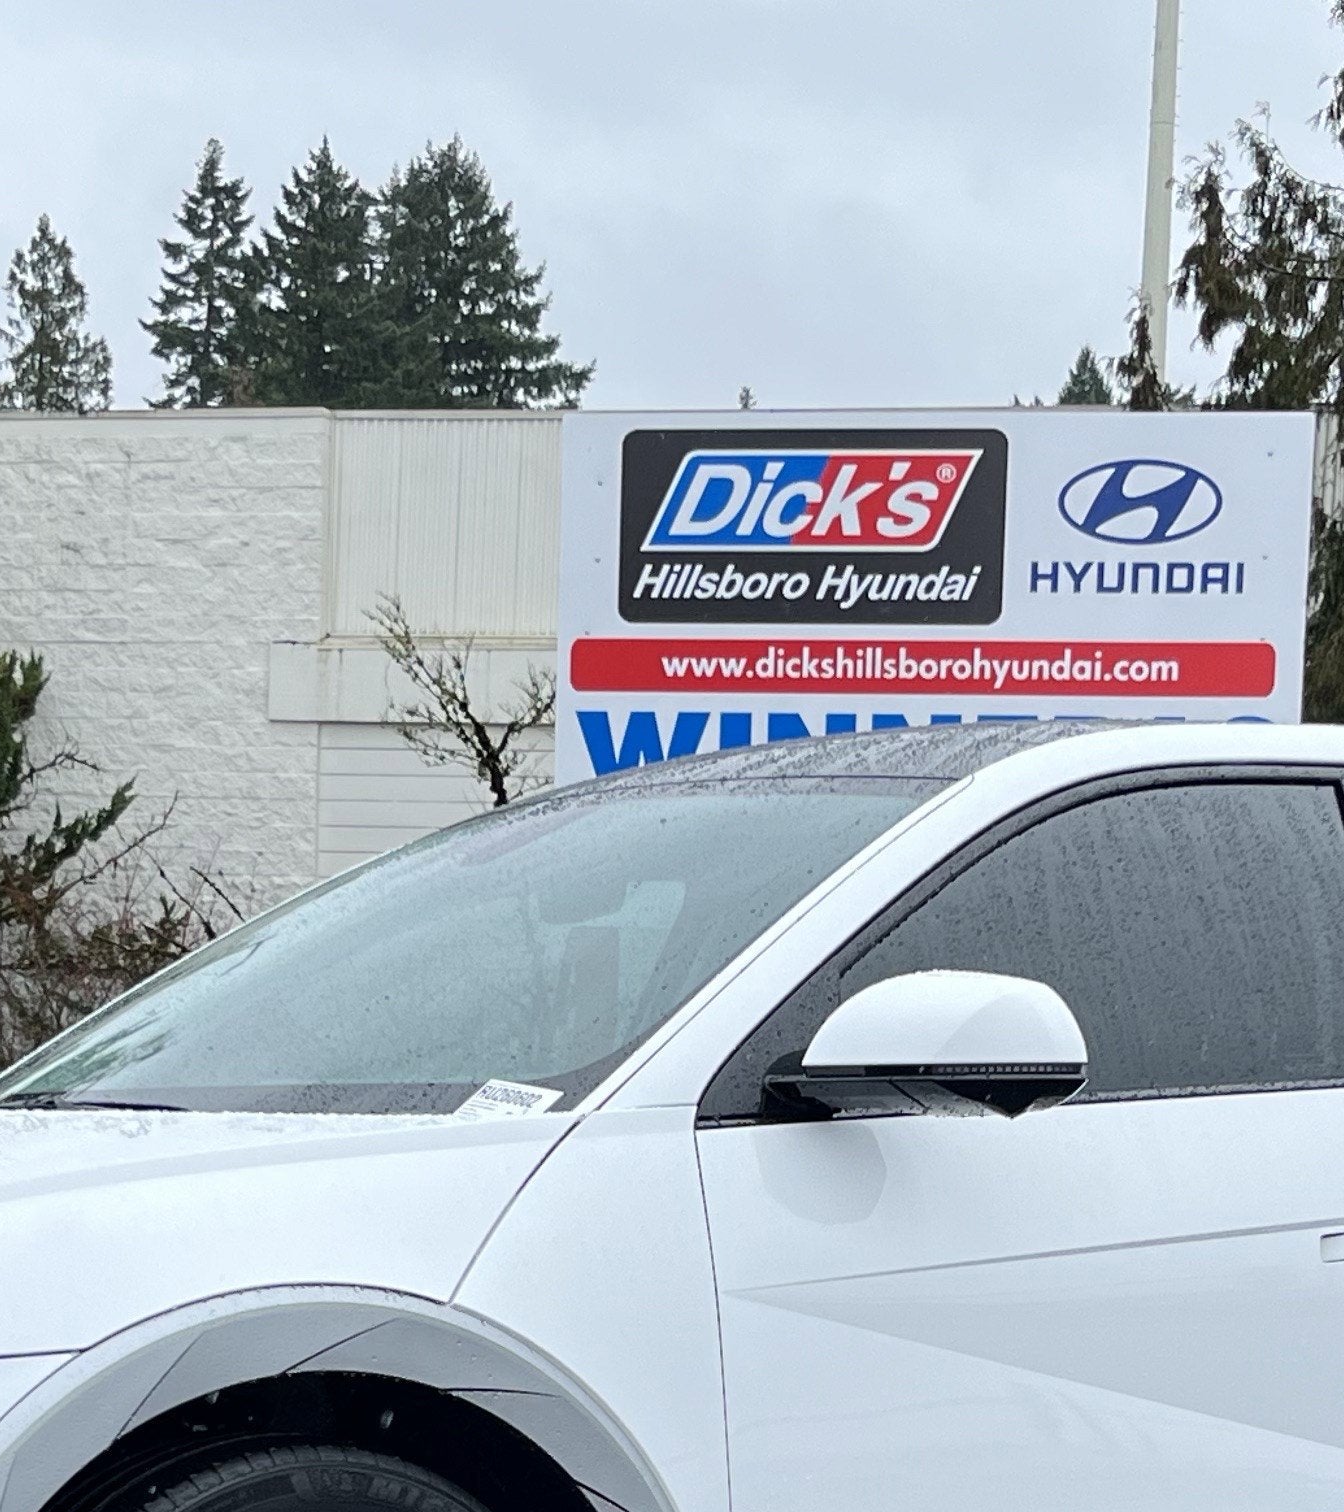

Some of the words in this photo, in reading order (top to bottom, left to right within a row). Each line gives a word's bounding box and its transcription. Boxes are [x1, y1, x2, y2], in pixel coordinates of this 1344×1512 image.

[632, 562, 810, 600] Hillsboro
[815, 565, 983, 609] Hyundai
[1029, 561, 1245, 595] HYUNDAI
[661, 646, 1179, 689] www.dickshillsborohyundai.com
